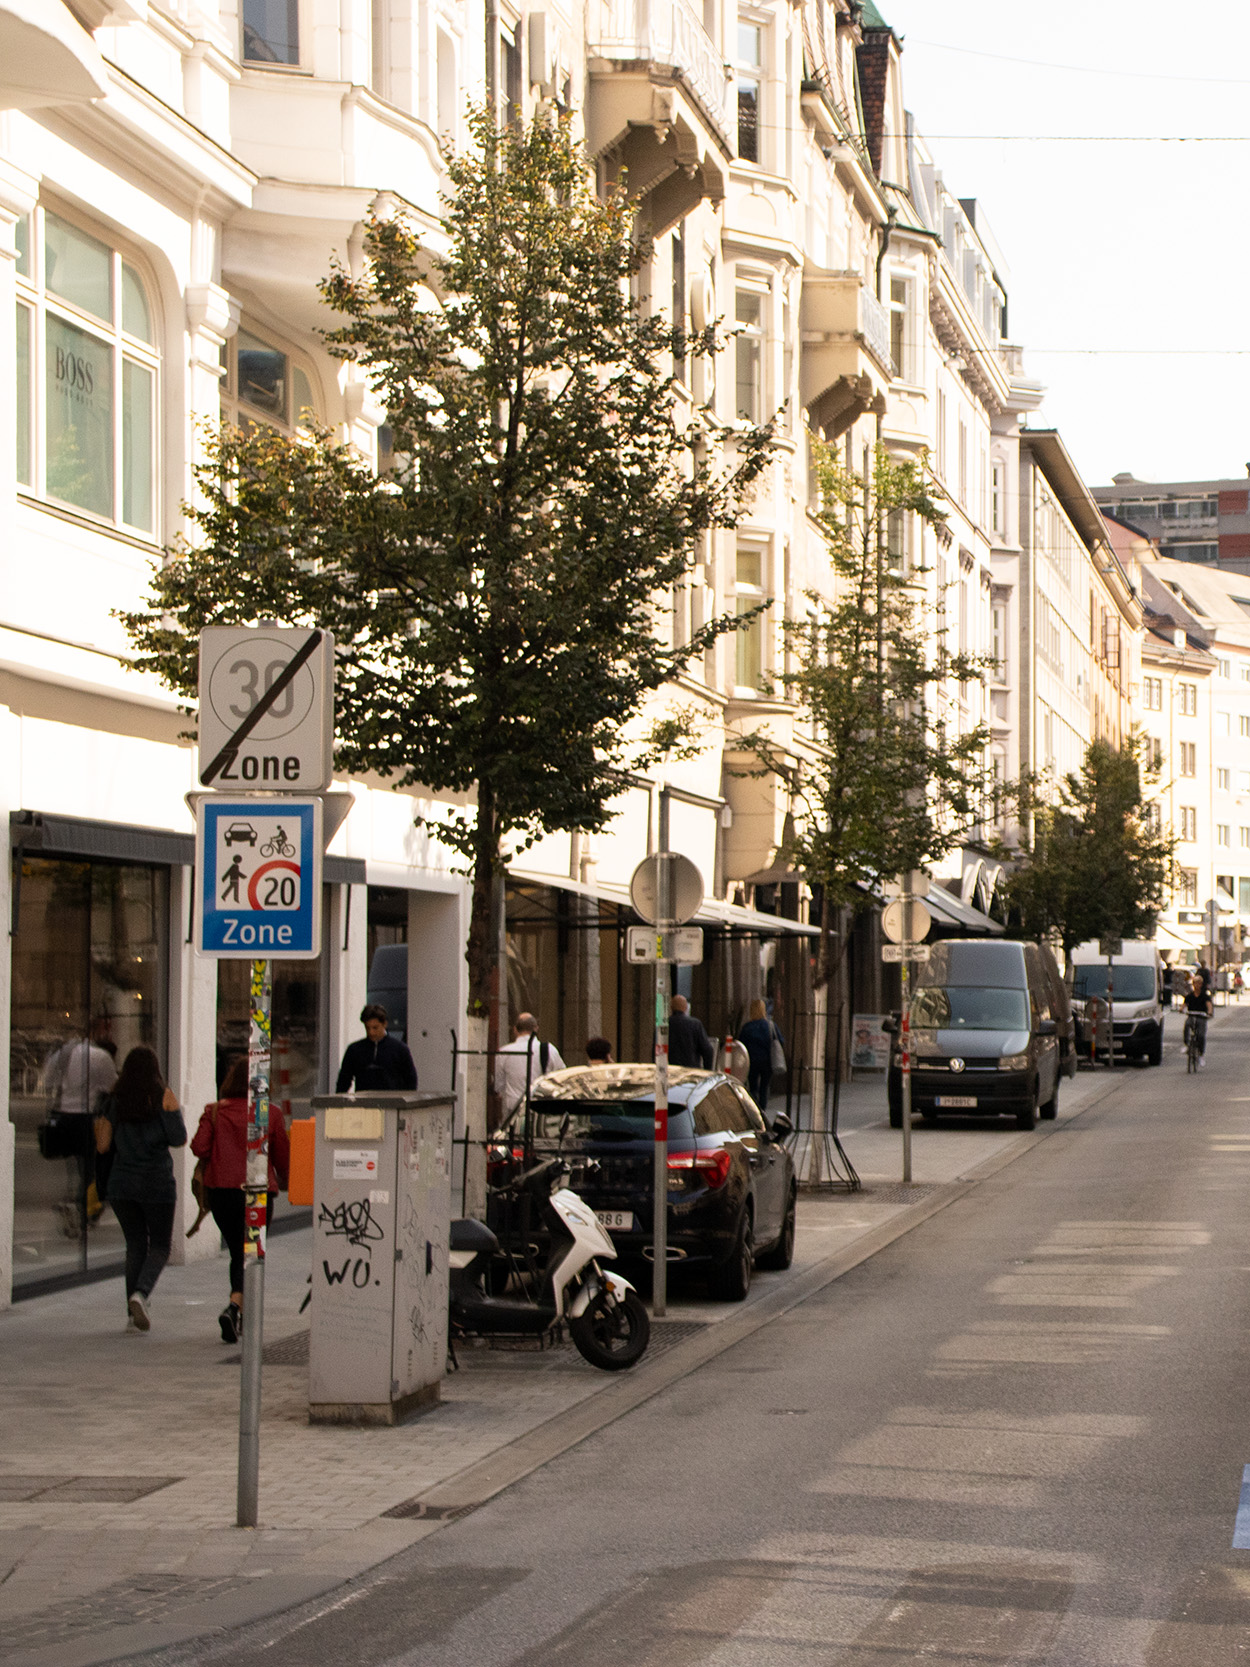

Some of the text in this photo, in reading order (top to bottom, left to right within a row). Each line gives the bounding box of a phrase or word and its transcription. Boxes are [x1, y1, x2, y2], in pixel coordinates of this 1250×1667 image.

[56, 346, 94, 395] BOSS
[229, 659, 294, 719] 30
[220, 748, 300, 781] Zone
[264, 876, 296, 907] 20
[222, 918, 293, 945] Zone
